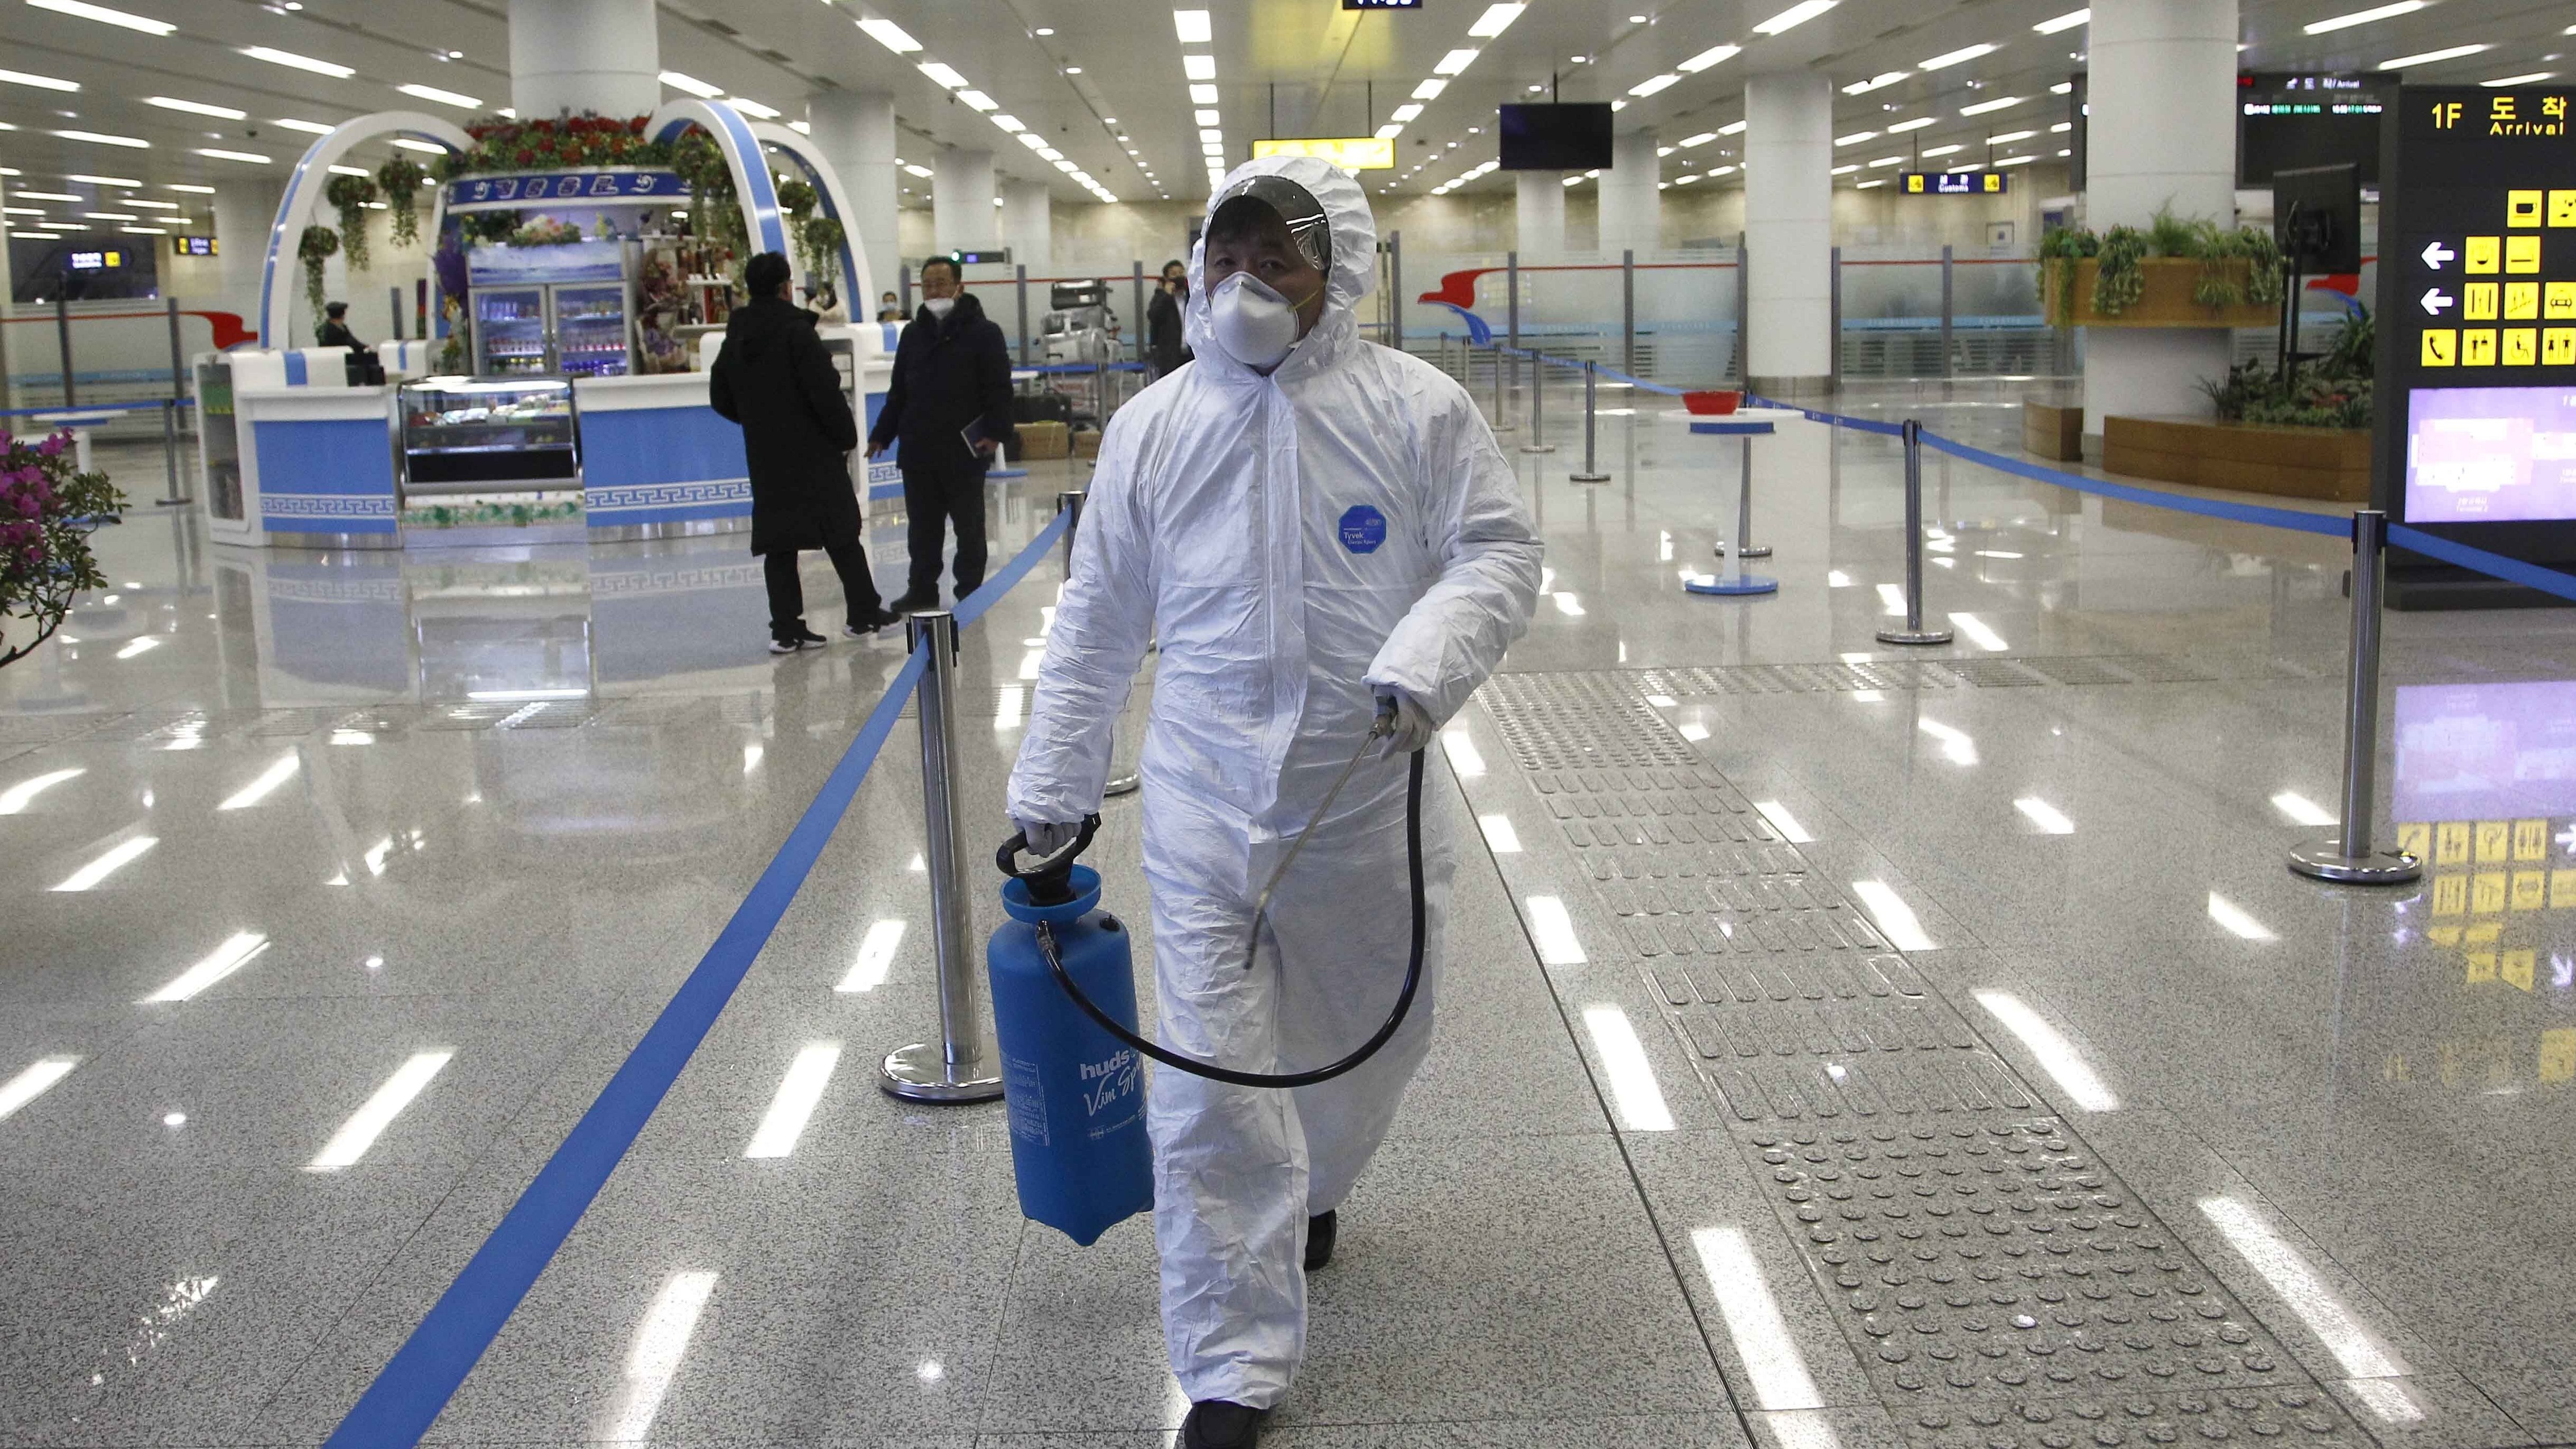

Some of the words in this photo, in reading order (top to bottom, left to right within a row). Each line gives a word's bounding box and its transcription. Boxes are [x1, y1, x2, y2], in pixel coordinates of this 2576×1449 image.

[2432, 103, 2463, 130] 1F
[2490, 122, 2564, 135] Arrival
[1343, 531, 1364, 540] Tyvek
[1083, 1072, 1116, 1116] Vim
